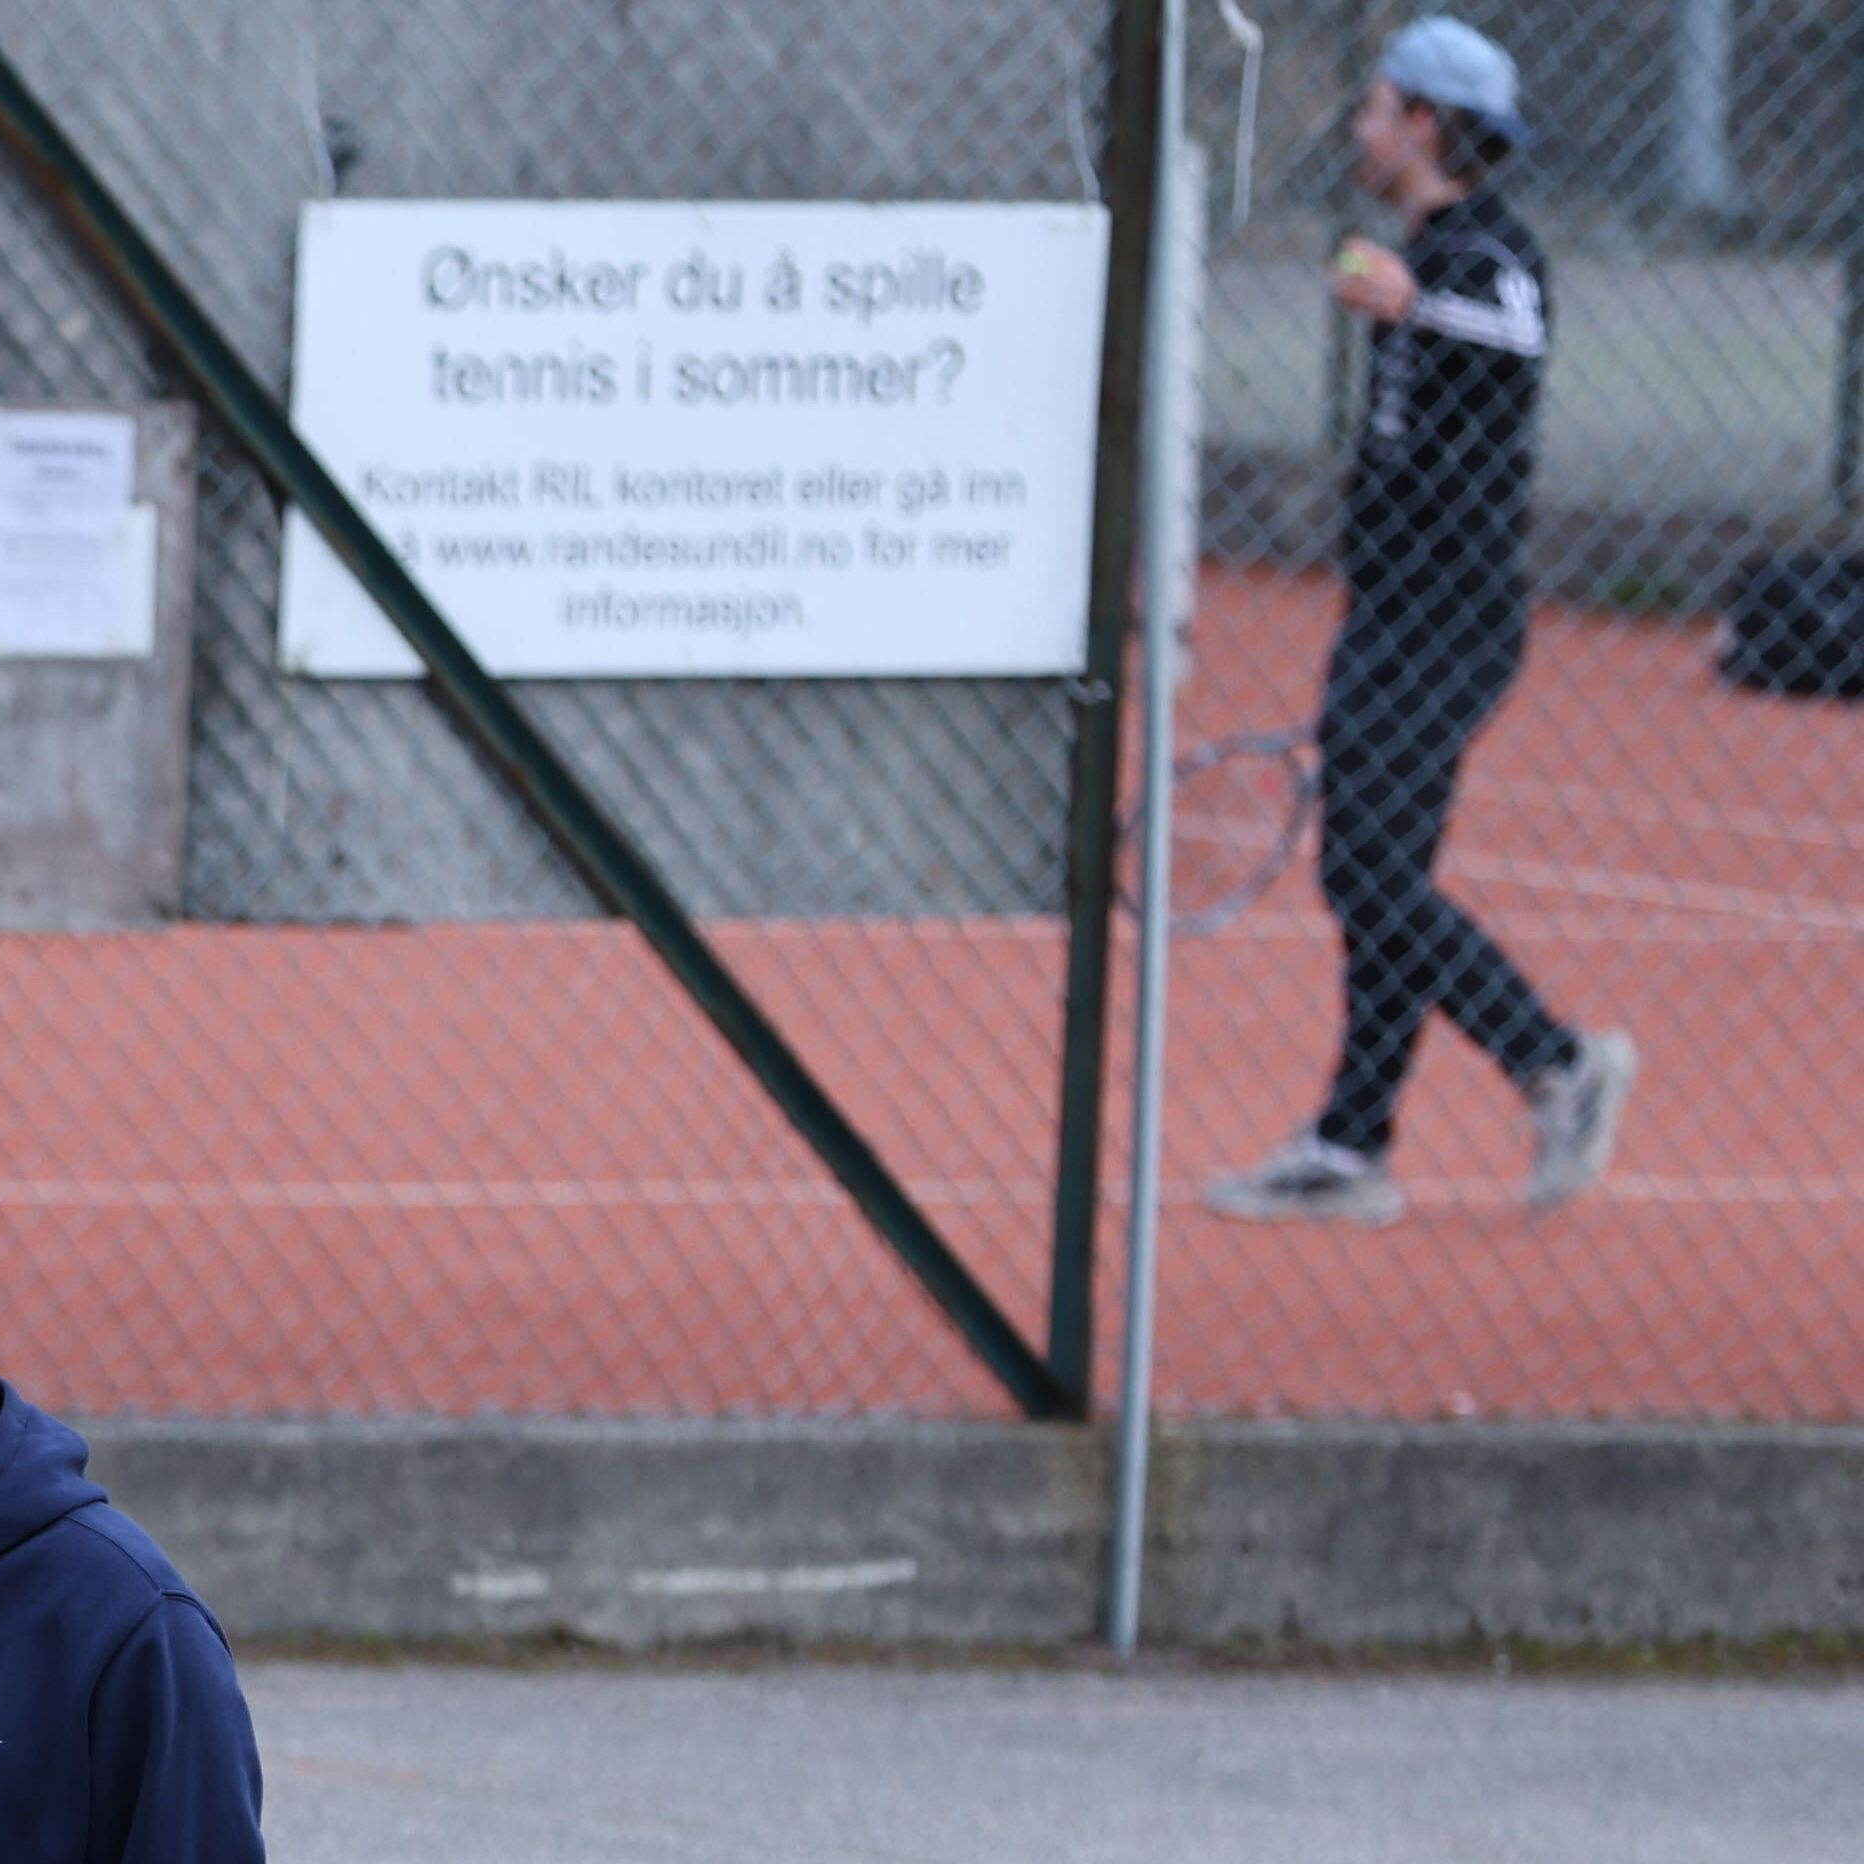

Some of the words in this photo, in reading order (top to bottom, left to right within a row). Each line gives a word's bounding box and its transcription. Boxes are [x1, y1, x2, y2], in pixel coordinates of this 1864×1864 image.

[422, 246, 650, 312] Ønsker
[665, 248, 744, 312] du
[763, 245, 803, 312] å
[822, 247, 986, 328] spille
[431, 339, 619, 404] tennis
[635, 337, 653, 403] i
[671, 337, 967, 405] sommer?
[358, 464, 521, 506] Kontakt
[531, 464, 599, 506] RIL
[615, 465, 784, 507] kontoret
[795, 465, 884, 509] eller
[895, 463, 950, 521] gå
[962, 464, 1027, 506] inn
[865, 525, 917, 570] for
[930, 530, 1015, 568] mer
